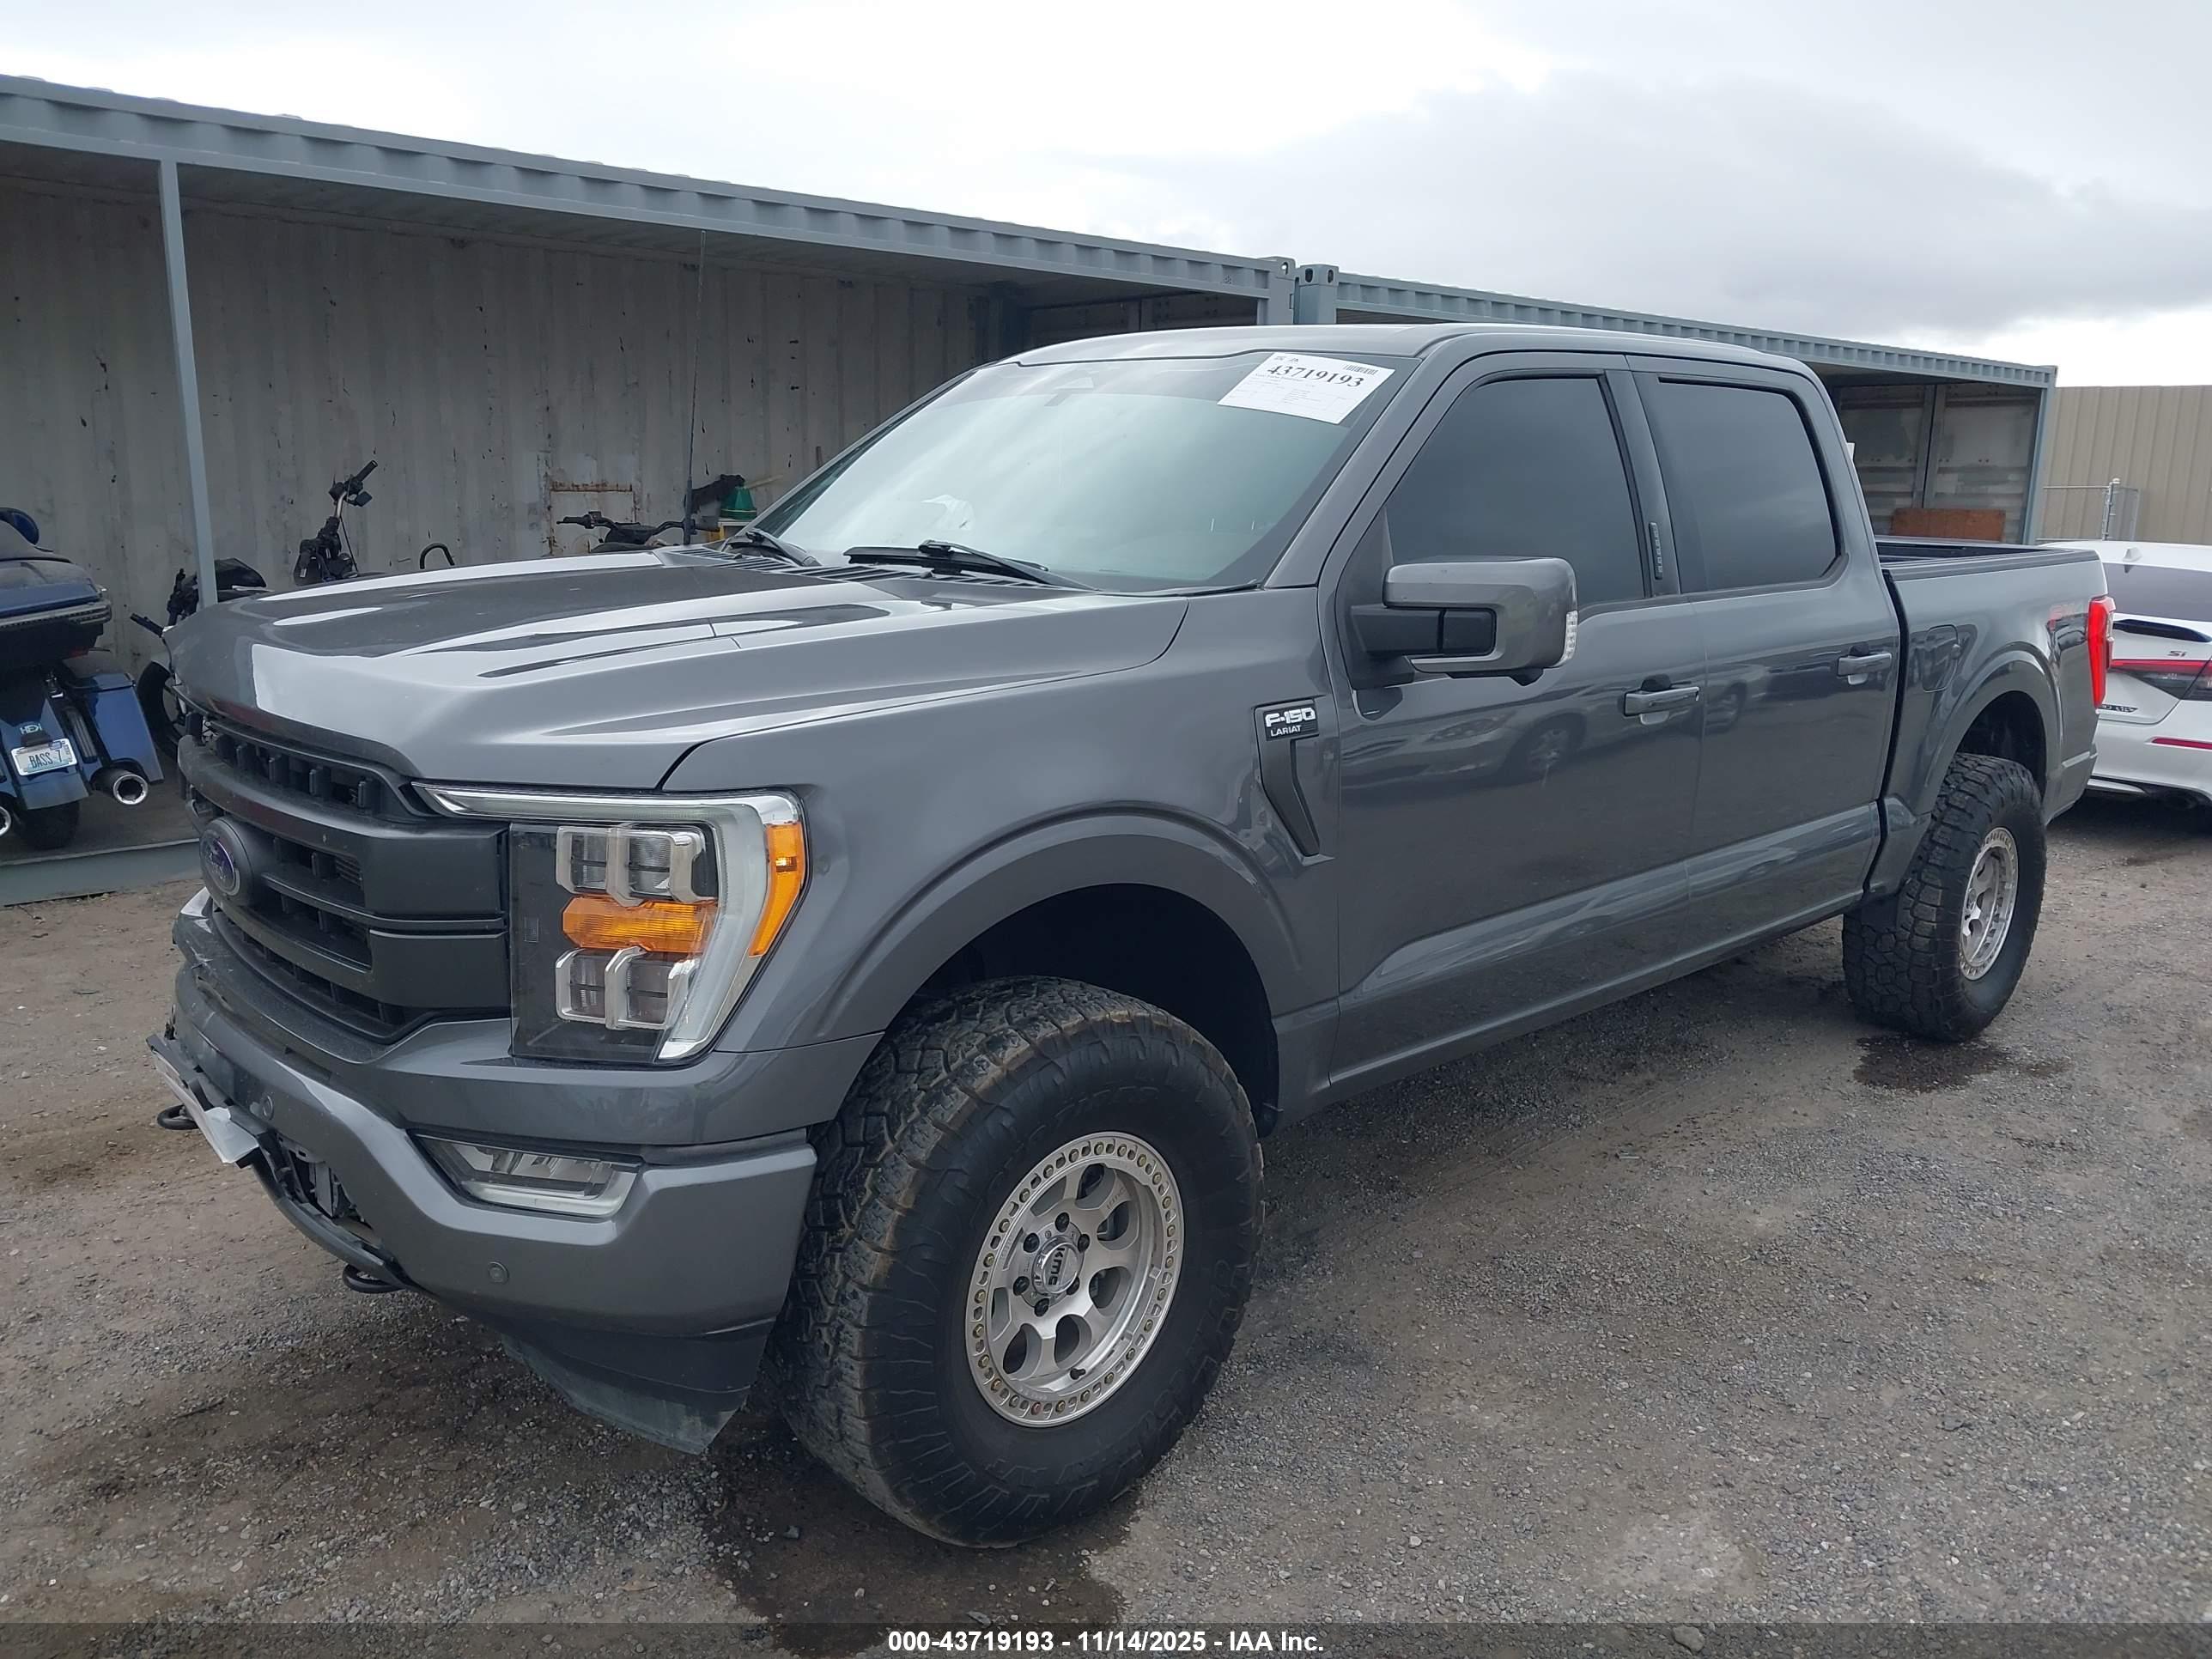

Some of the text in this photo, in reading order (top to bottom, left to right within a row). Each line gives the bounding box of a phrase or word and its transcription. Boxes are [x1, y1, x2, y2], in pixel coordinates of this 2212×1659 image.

[1267, 364, 1364, 387] 43719193
[1265, 707, 1316, 727] F-150
[1270, 725, 1302, 737] LARIAT
[28, 752, 53, 769] BASS
[55, 750, 63, 763] 7
